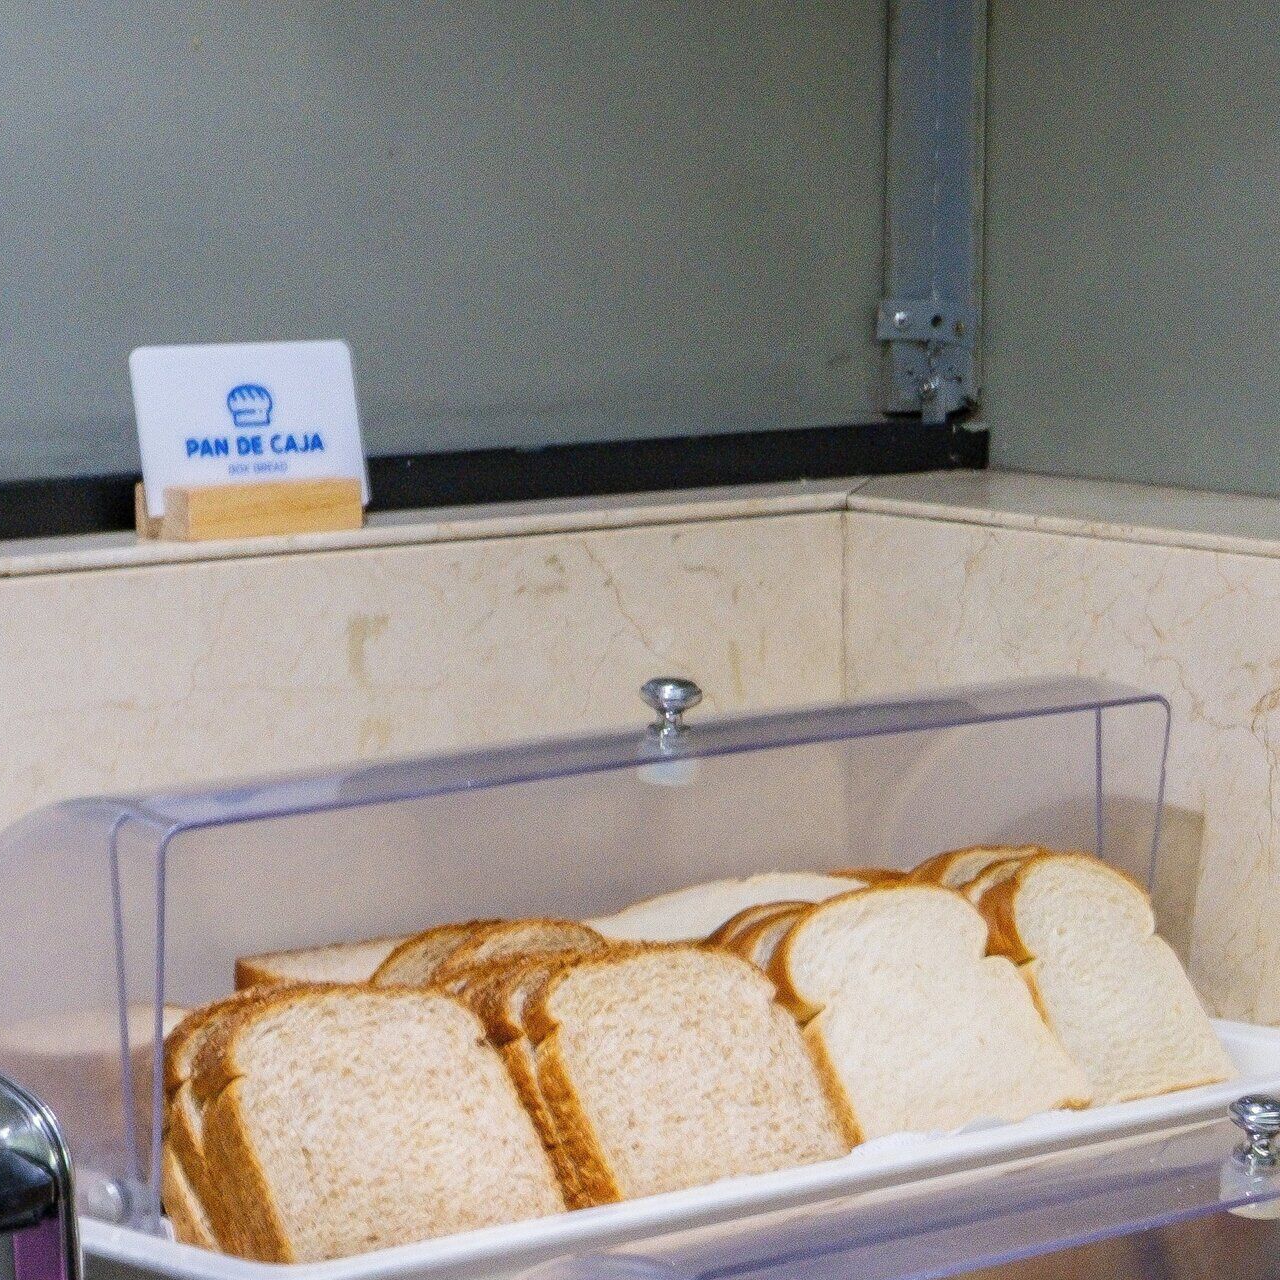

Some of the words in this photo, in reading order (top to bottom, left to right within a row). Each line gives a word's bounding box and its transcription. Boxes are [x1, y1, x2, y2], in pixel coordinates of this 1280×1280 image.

[185, 436, 229, 457] PAN
[236, 435, 264, 456] DE
[270, 432, 325, 454] CAJA
